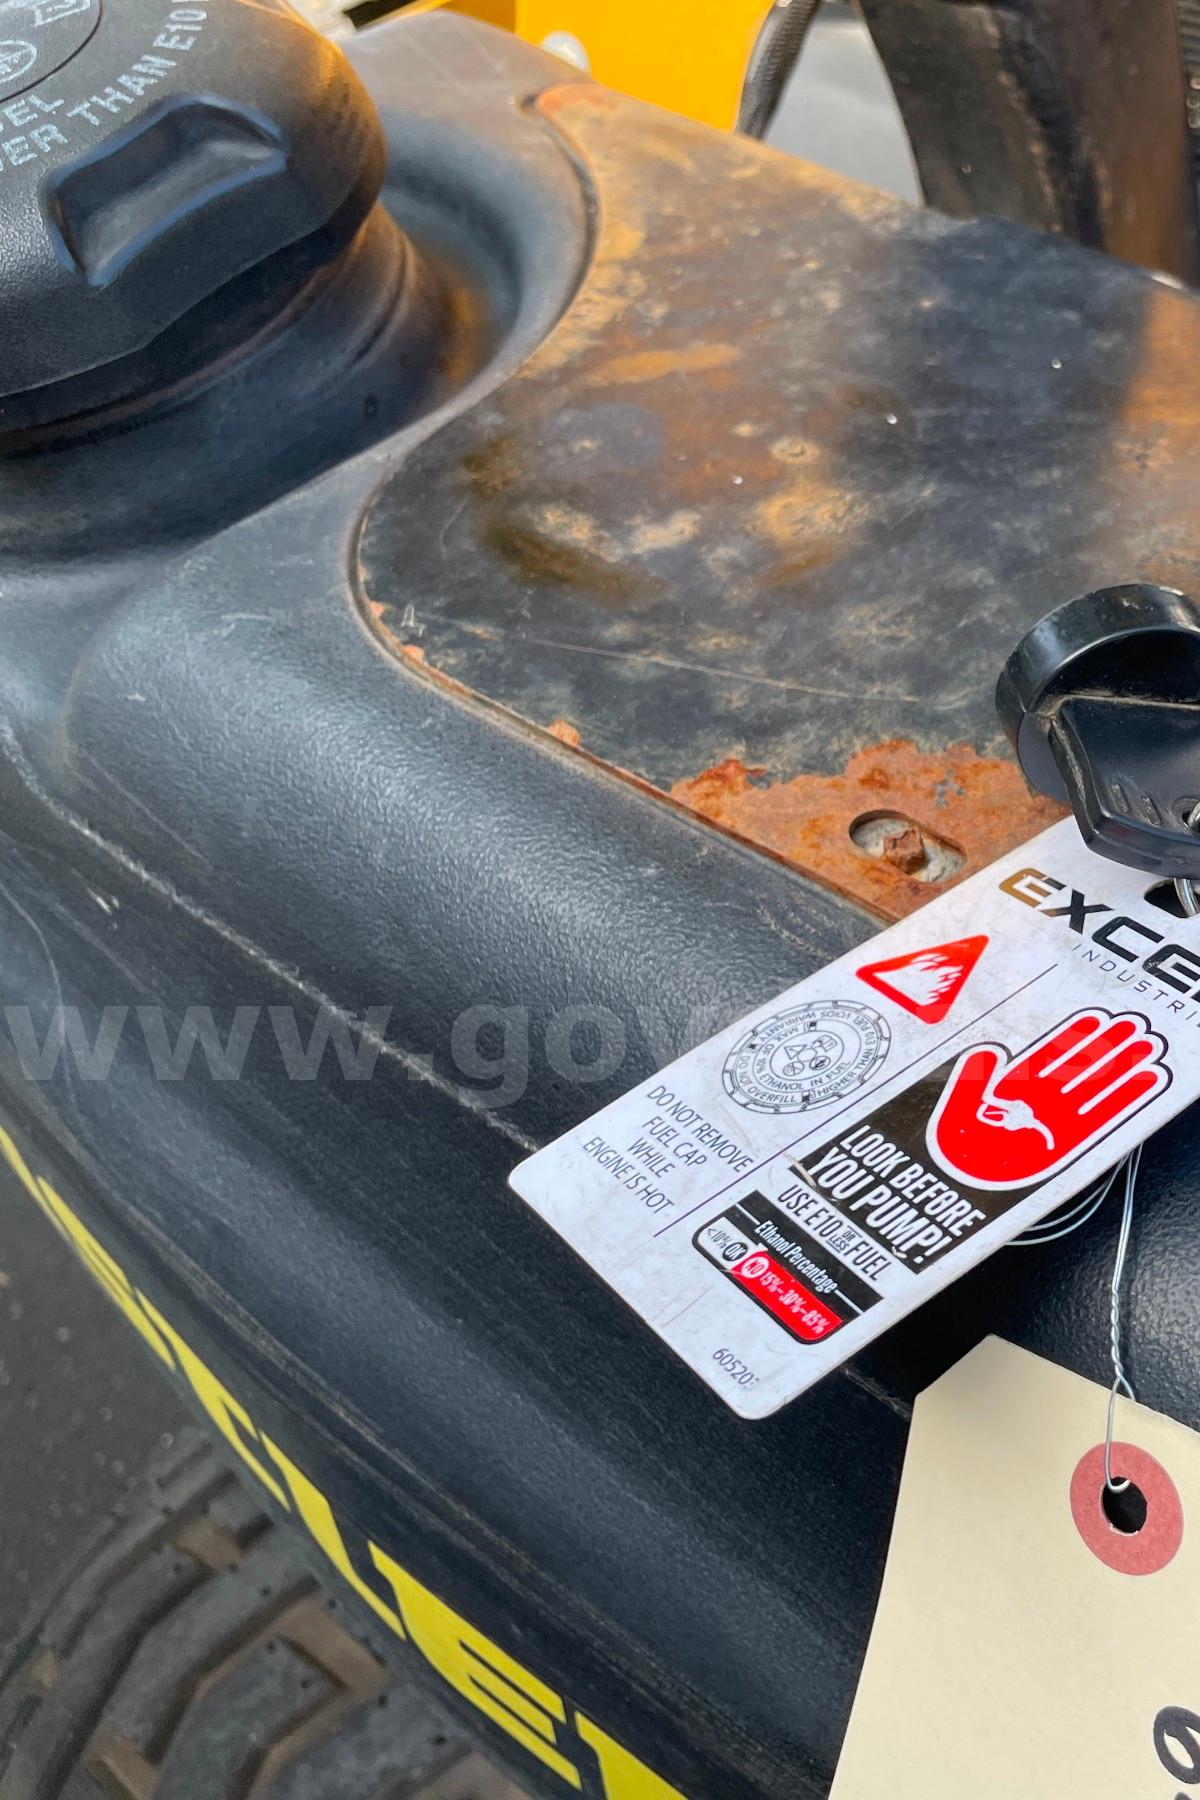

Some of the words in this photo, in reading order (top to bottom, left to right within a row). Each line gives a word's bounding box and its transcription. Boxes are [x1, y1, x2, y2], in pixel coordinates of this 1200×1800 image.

[0, 124, 68, 171] ER
[67, 55, 177, 126] THAN
[153, 8, 208, 52] E10
[0, 95, 64, 132] EL
[776, 1025, 800, 1042] MAX
[739, 1055, 750, 1069] DO
[747, 1086, 797, 1103] OVERFILL
[762, 1073, 806, 1091] ETHANOL
[810, 1077, 823, 1086] IN
[817, 1072, 858, 1096] HIGHER
[858, 1050, 875, 1073] THAN
[826, 1060, 851, 1080] FUEL
[641, 1115, 680, 1148] FUEL
[673, 1142, 708, 1167] CAP
[646, 1085, 675, 1106] DO
[665, 1101, 703, 1128] NOT
[692, 1122, 754, 1173] REMOVE
[582, 1136, 636, 1180] ENGINE
[623, 1172, 647, 1190] IS
[635, 1184, 675, 1214] HOT
[627, 1137, 676, 1178] WHILE
[777, 1184, 819, 1217] USE
[839, 1125, 911, 1178] LOOK
[889, 1163, 986, 1237] BEFORE
[804, 1208, 843, 1237] E10
[808, 1146, 875, 1200] YOU
[849, 1184, 952, 1264] PUMP!
[727, 1243, 746, 1261] OK
[829, 1234, 850, 1251] LESS
[841, 1230, 856, 1241] OR
[754, 1220, 795, 1257] Ethanol
[789, 1245, 839, 1294] Percentage
[843, 1241, 892, 1281] FUEL
[712, 1348, 760, 1389] 60520
